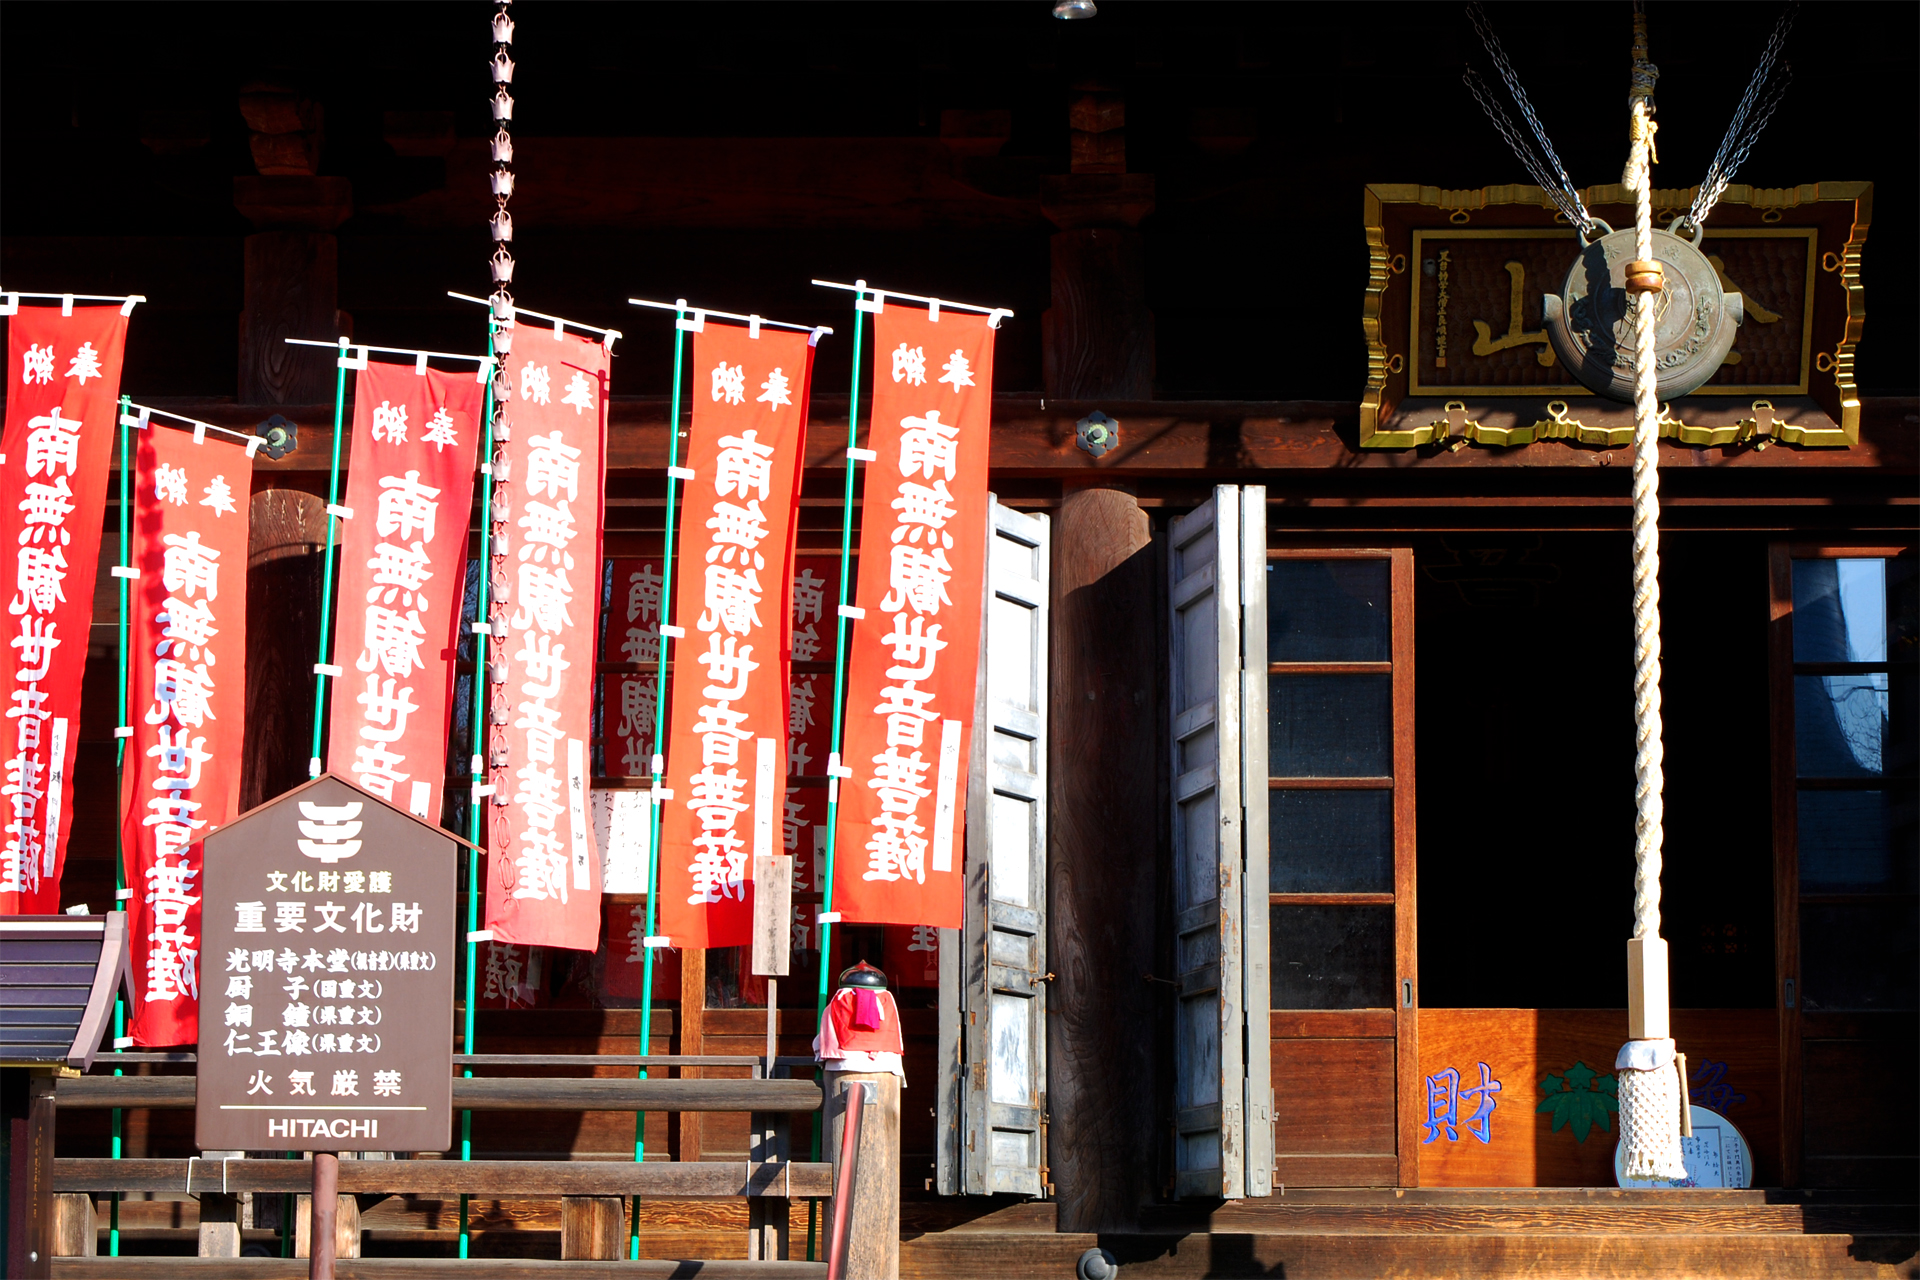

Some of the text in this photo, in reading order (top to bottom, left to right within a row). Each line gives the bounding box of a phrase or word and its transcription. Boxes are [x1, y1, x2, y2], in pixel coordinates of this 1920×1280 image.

[265, 870, 392, 894] 文化財愛護
[233, 900, 423, 934] 重要文化財
[247, 1069, 402, 1097] 火気厳禁
[1422, 1061, 1502, 1144] 財
[268, 1118, 378, 1139] HITACHI
